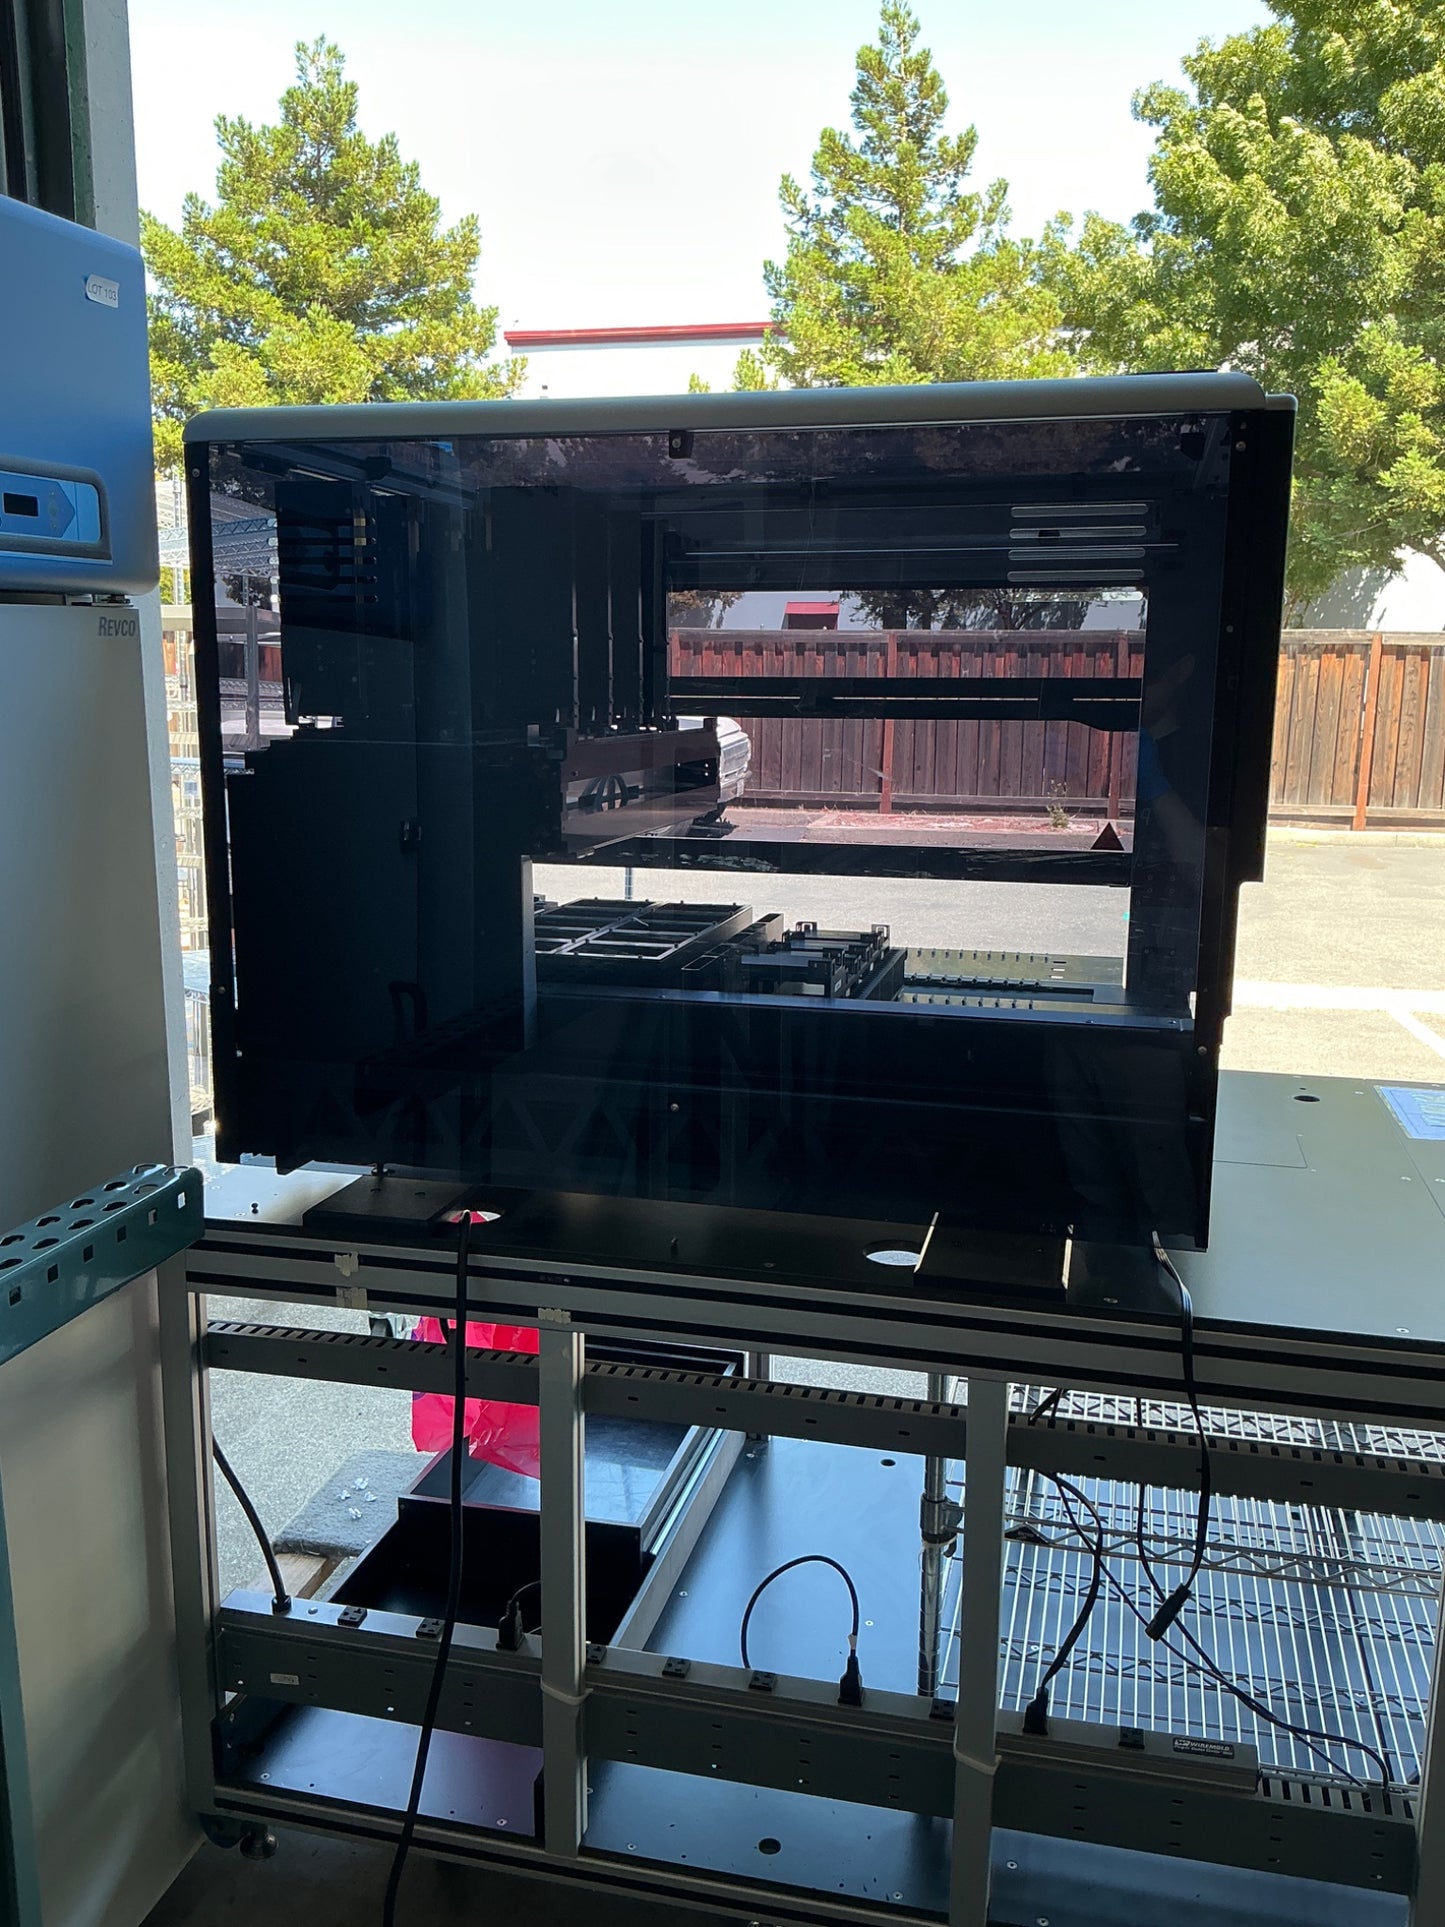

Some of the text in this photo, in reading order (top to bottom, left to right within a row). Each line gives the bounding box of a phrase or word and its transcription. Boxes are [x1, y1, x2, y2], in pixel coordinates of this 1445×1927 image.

[88, 283, 117, 301] LOT 103
[98, 616, 136, 637] REVCO
